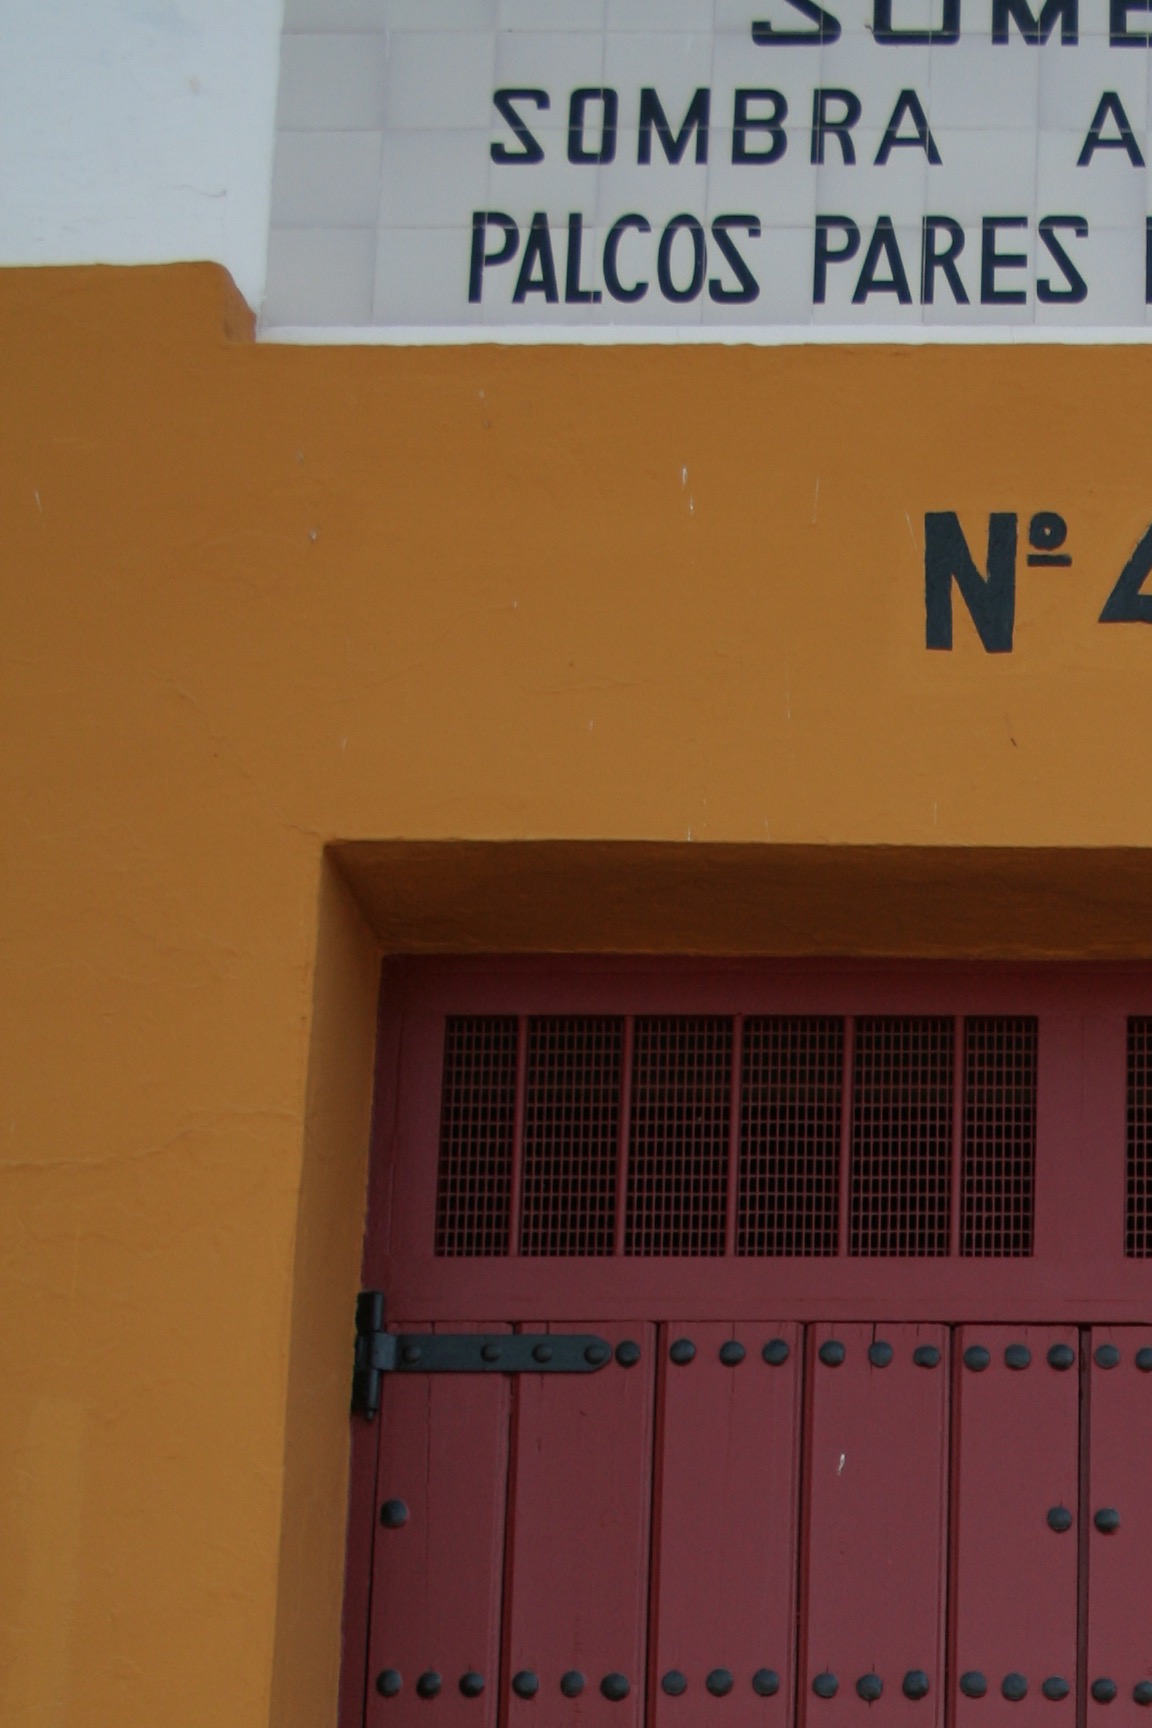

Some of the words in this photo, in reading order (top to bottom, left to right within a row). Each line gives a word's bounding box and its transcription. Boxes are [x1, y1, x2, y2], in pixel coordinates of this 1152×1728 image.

[489, 87, 943, 167] SOMBRA
[467, 210, 762, 305] PALCOS
[811, 213, 1090, 306] PARES
